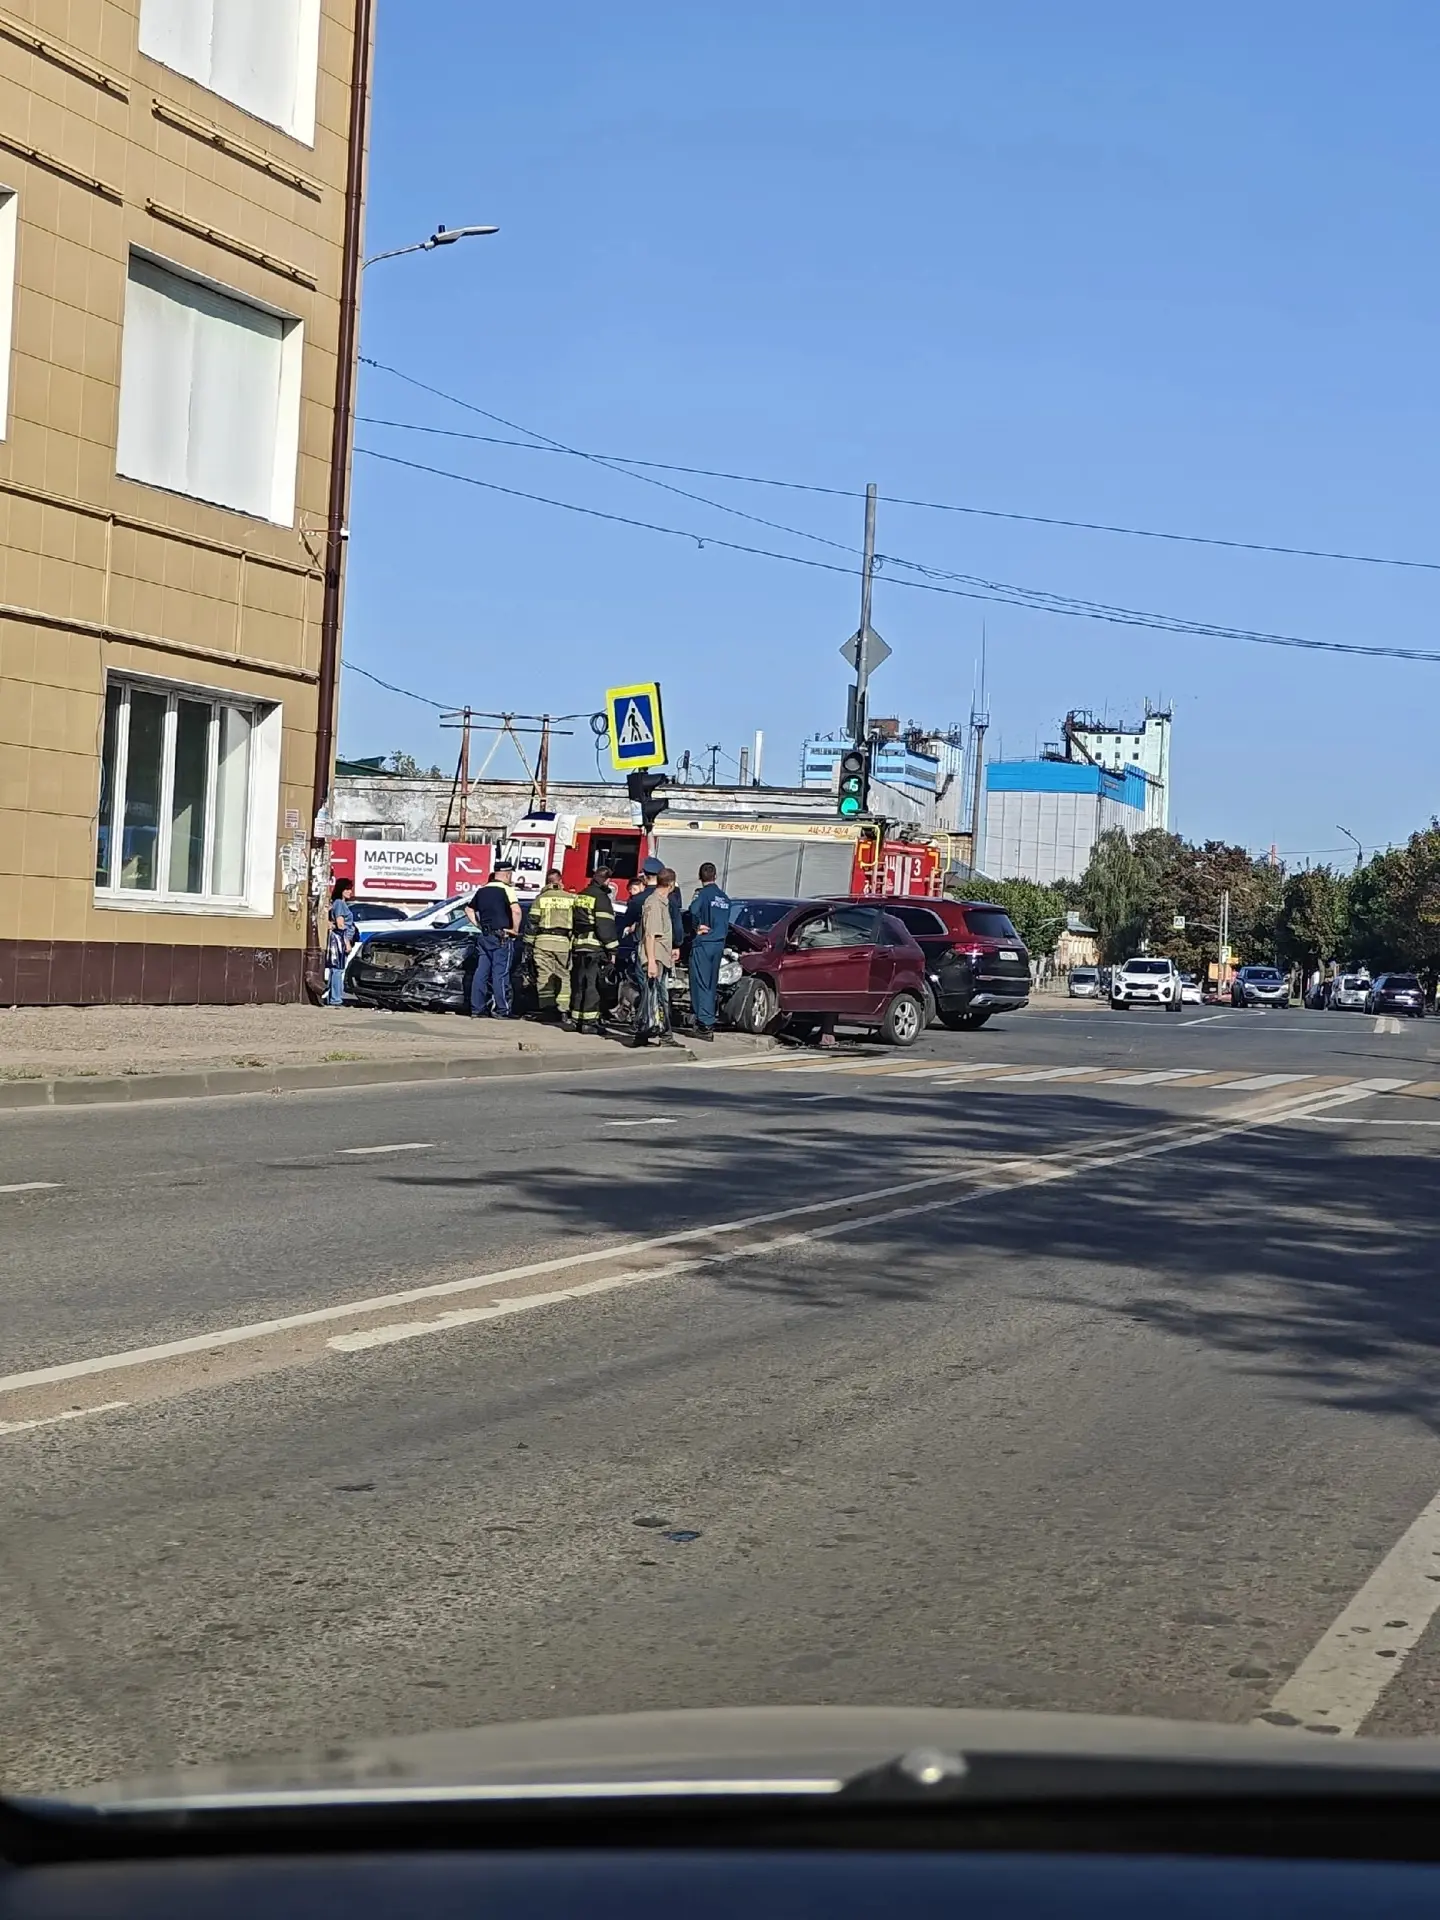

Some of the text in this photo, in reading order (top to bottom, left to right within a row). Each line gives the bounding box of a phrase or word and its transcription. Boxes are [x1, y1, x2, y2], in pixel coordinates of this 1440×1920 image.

[718, 823, 749, 831] ТЕЛЕФОН
[761, 824, 772, 832] 101
[364, 850, 438, 865] МАТРАСЫ
[913, 858, 921, 877] 3
[455, 881, 470, 892] 50
